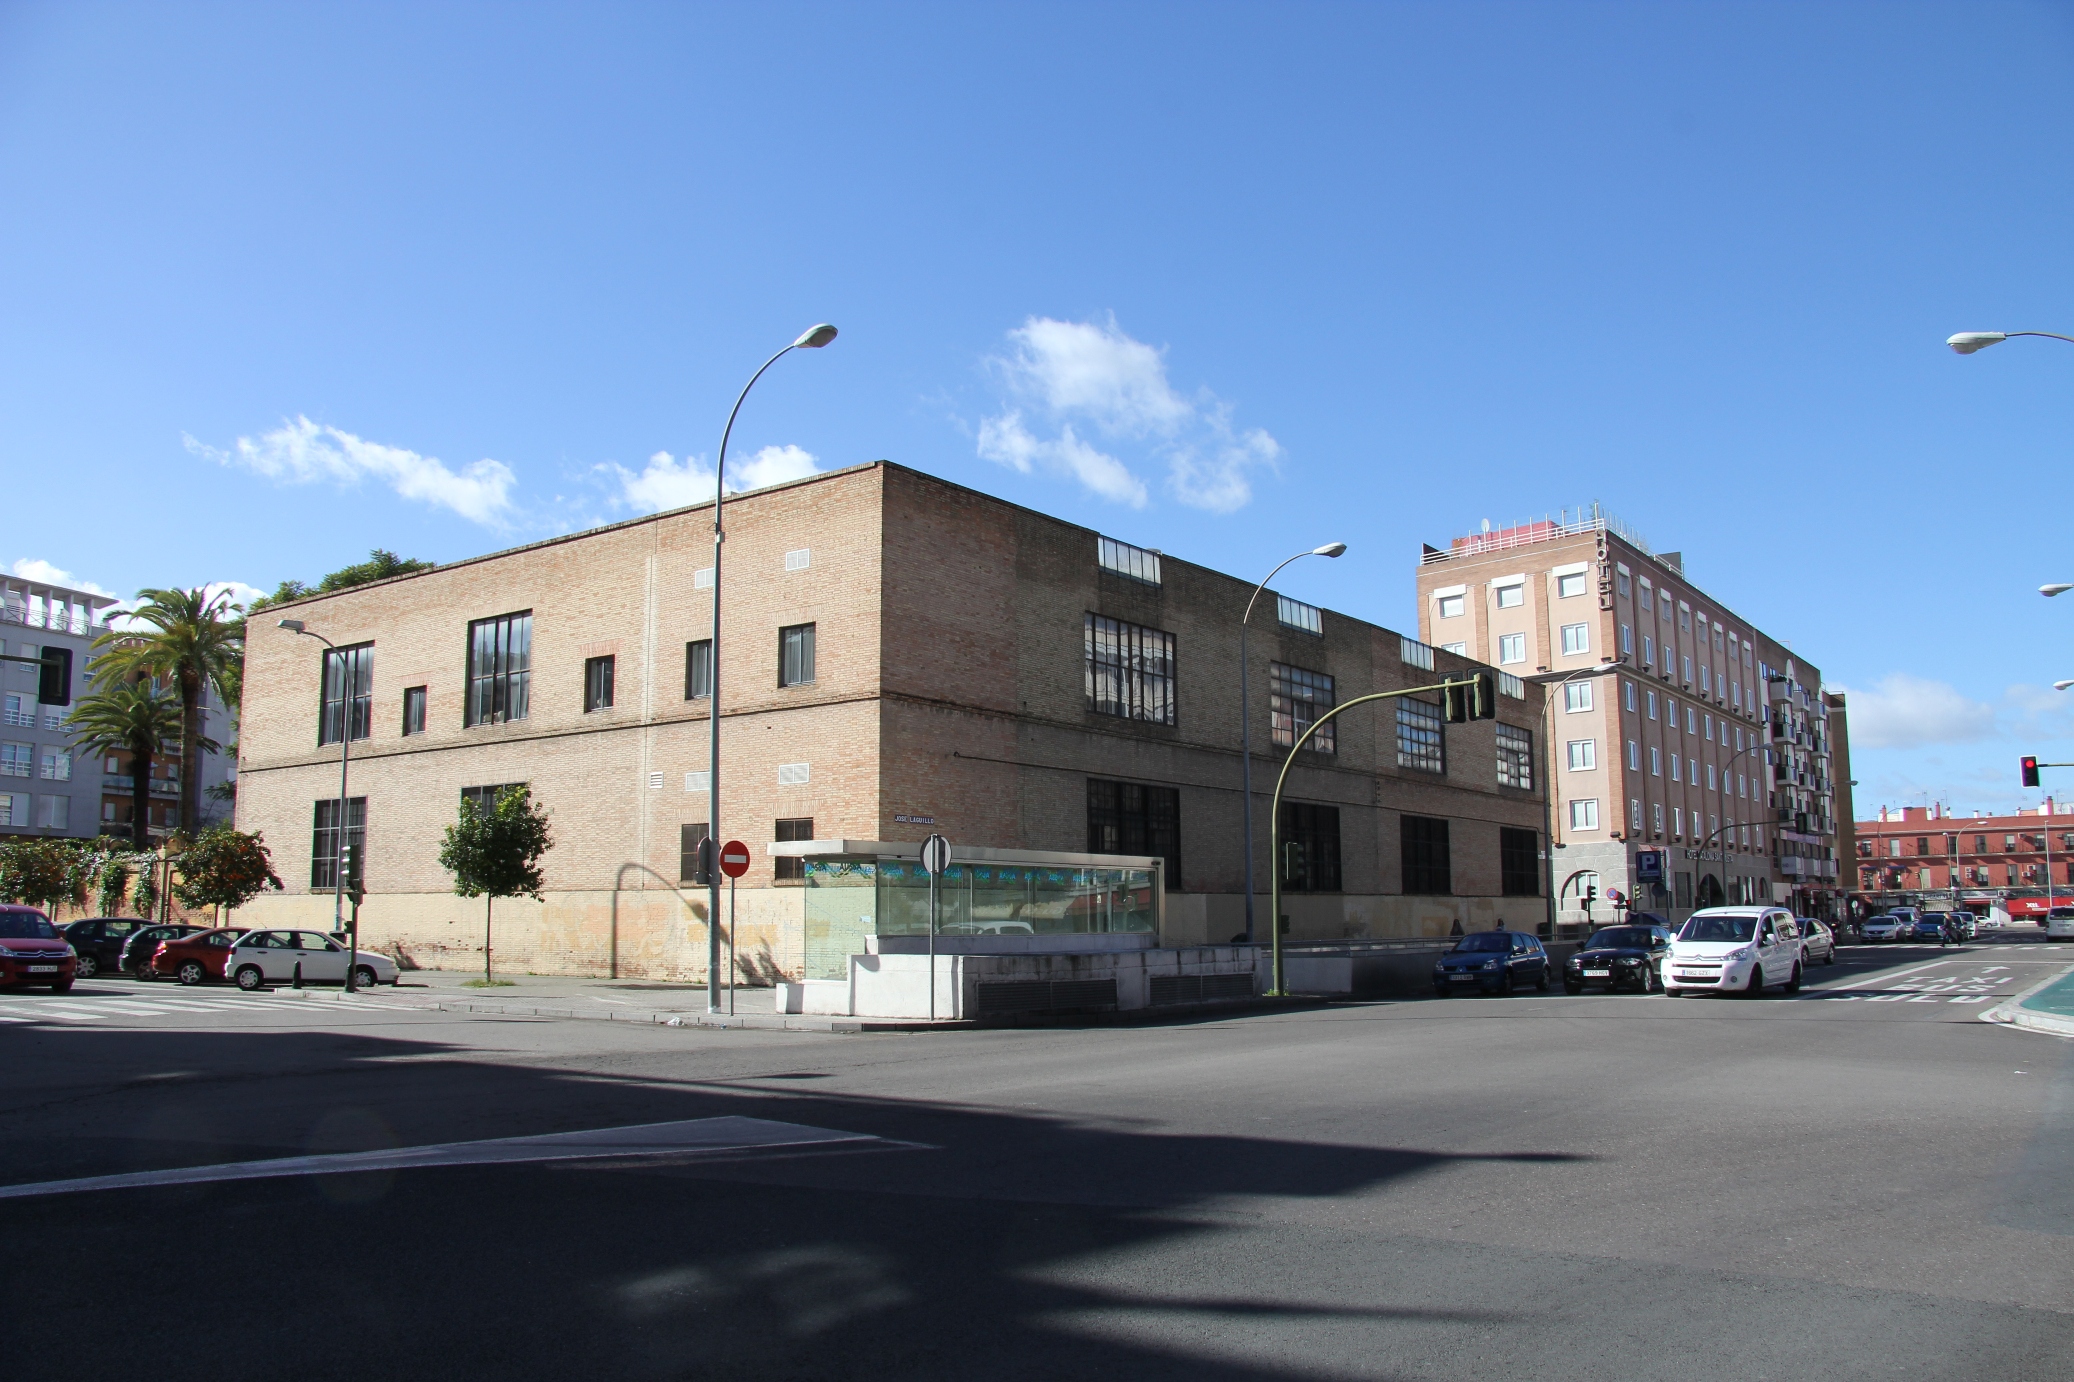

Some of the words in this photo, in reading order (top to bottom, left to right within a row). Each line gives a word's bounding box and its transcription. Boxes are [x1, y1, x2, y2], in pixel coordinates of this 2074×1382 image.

[1596, 529, 1612, 609] HOTEL
[895, 815, 908, 823] JOSE
[909, 816, 935, 825] LAGUILLO
[1641, 854, 1656, 870] P
[1902, 976, 2014, 984] TAXI
[1882, 984, 1996, 992] BUS
